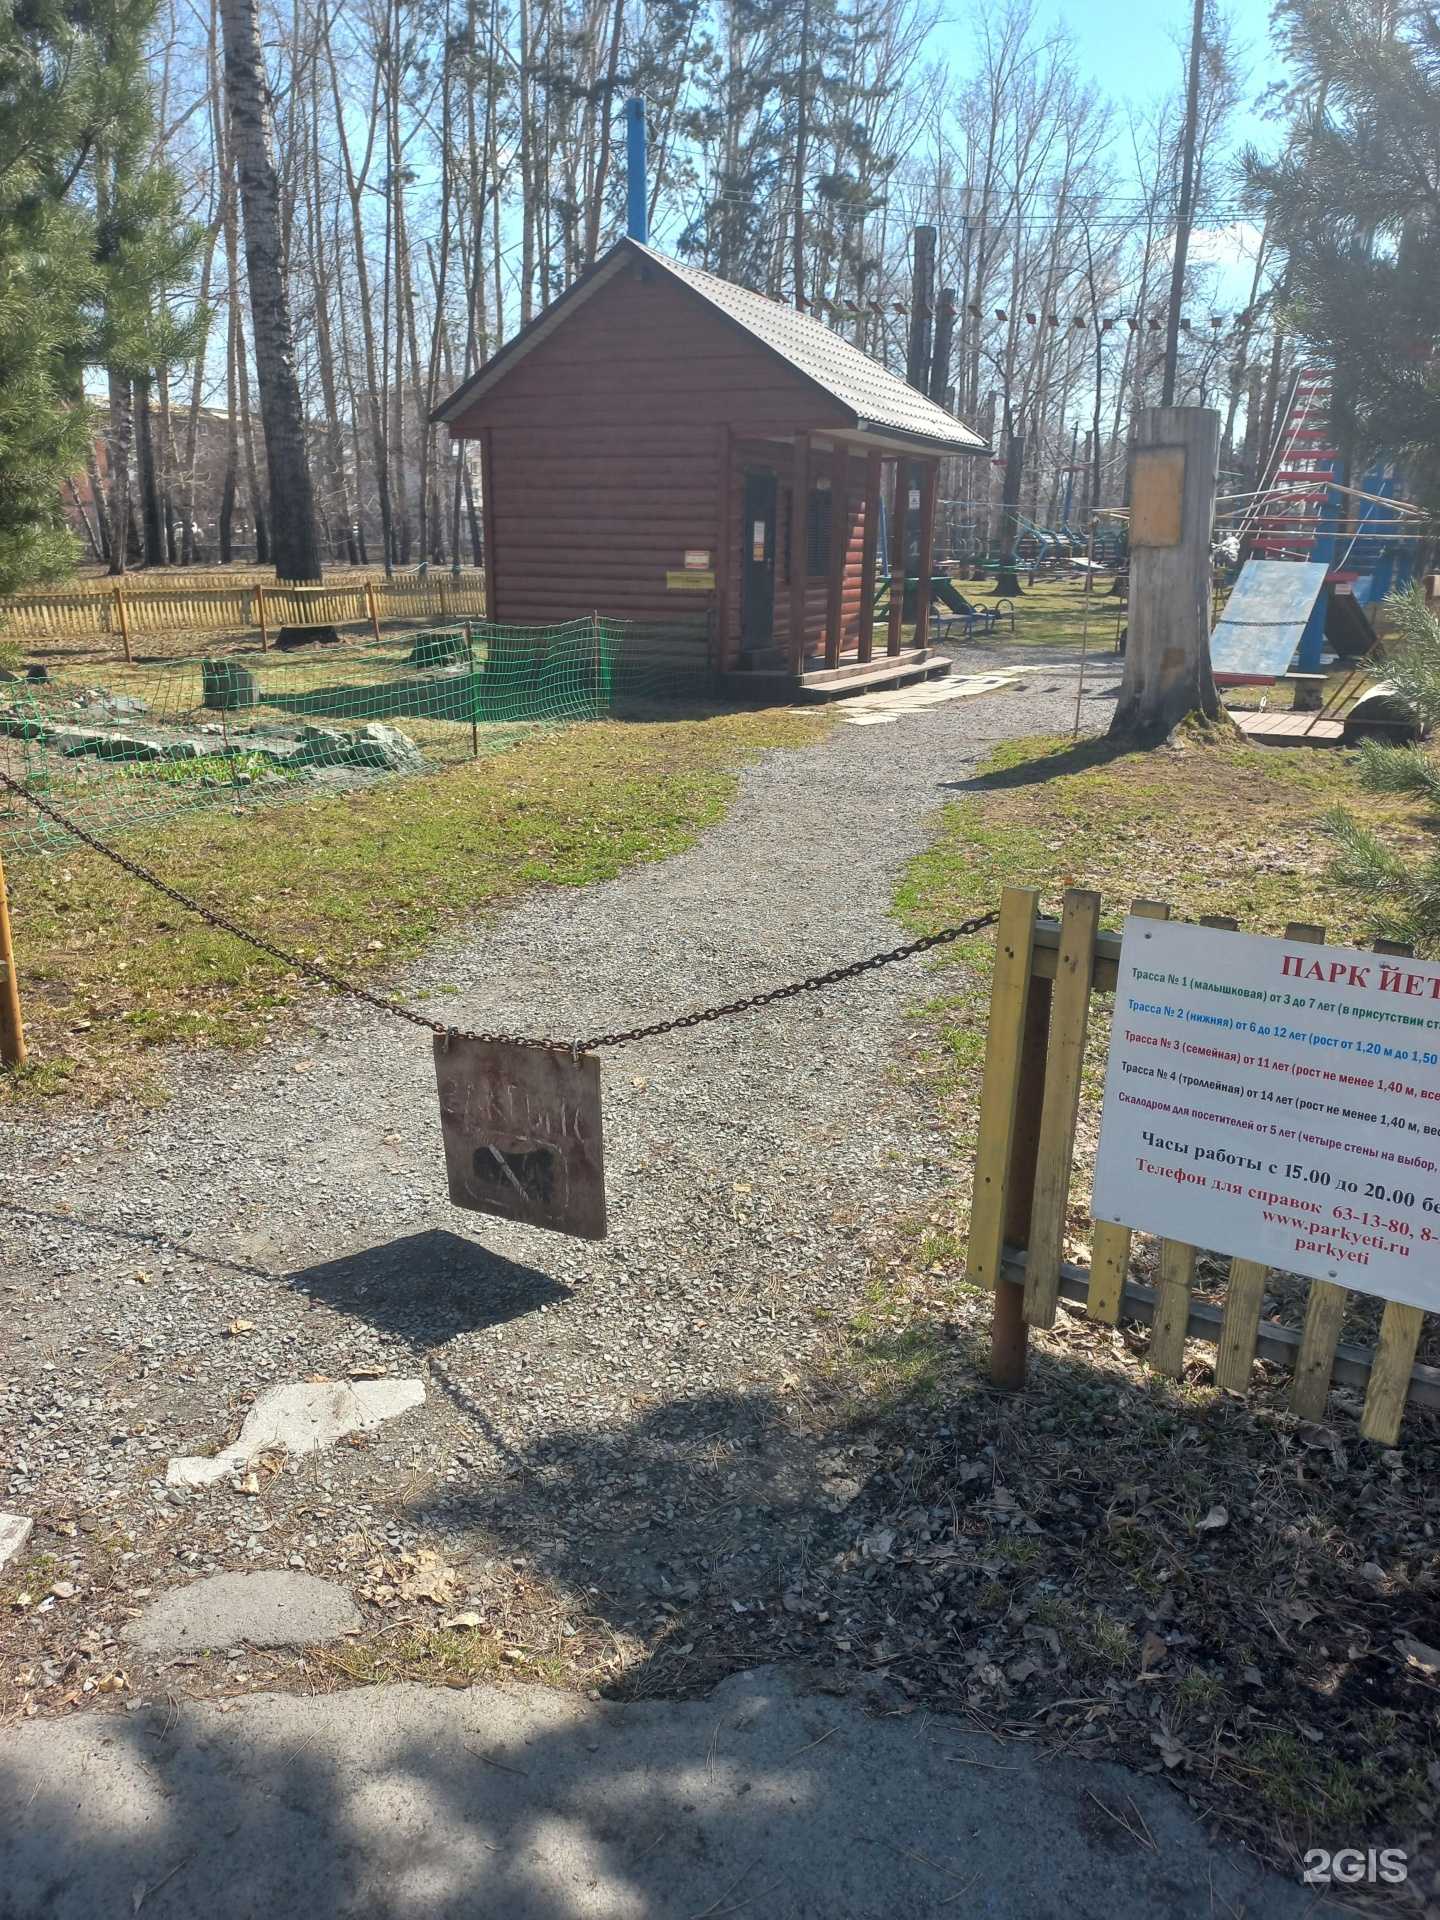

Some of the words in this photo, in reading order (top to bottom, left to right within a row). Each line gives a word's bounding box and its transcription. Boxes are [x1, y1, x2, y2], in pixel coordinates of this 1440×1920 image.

[1131, 968, 1165, 983] Трасса
[1168, 974, 1179, 985] №
[1181, 976, 1188, 987] 1
[1190, 978, 1267, 1002] (малышковая)
[1269, 993, 1282, 1003] от
[1283, 994, 1291, 1005] 3
[1292, 999, 1306, 1008] до
[1308, 998, 1316, 1009] 7
[1317, 1002, 1336, 1012] лет
[1338, 1003, 1350, 1016] (в
[1352, 1008, 1424, 1027] присутствии
[1426, 1020, 1440, 1030] ст
[1280, 955, 1371, 988] ПАРК
[1124, 1030, 1158, 1046] Трасса
[1160, 1037, 1171, 1049] №
[1173, 1040, 1180, 1050] 3
[1182, 1041, 1241, 1064] (семейная)
[1243, 1055, 1256, 1065] от
[1257, 1057, 1270, 1068] 11
[1272, 1061, 1290, 1072] лет
[1291, 1063, 1321, 1078] (рост
[1322, 1071, 1337, 1081] не
[1339, 1074, 1375, 1088] менее
[1377, 1079, 1403, 1094] 1,40
[1405, 1086, 1418, 1098] м,
[1128, 999, 1161, 1015] Трасса
[1164, 1006, 1175, 1017] №
[1177, 1008, 1184, 1019] 2
[1186, 1010, 1233, 1030] (нижняя)
[1235, 1021, 1248, 1031] от
[1249, 1022, 1257, 1033] 6
[1257, 1026, 1271, 1036] до
[1273, 1026, 1287, 1038] 12
[1289, 1031, 1307, 1042] лет
[1309, 1032, 1339, 1048] (рост
[1340, 1040, 1353, 1050] от
[1356, 1041, 1381, 1055] 1,20
[1383, 1047, 1393, 1057] м
[1394, 1050, 1409, 1060] до
[1412, 1050, 1438, 1065] 1,50
[1121, 1061, 1154, 1077] Трасса
[1156, 1068, 1168, 1080] №
[1169, 1071, 1177, 1081] 4
[1178, 1073, 1244, 1098] (троллейная)
[1246, 1088, 1259, 1099] от
[1261, 1090, 1274, 1102] 14
[1276, 1095, 1294, 1105] лет
[1295, 1096, 1325, 1112] (рост
[1326, 1105, 1340, 1115] не
[1342, 1107, 1378, 1123] менее
[1380, 1114, 1406, 1129] 1,40
[1408, 1121, 1420, 1134] м,
[1118, 1091, 1171, 1112] Скалодром
[1172, 1103, 1190, 1116] для
[1191, 1109, 1254, 1131] посетителей
[1256, 1124, 1268, 1134] от
[1269, 1124, 1277, 1135] 5
[1278, 1129, 1297, 1140] лет
[1298, 1130, 1342, 1151] (четыре
[1344, 1142, 1379, 1158] стены
[1381, 1151, 1395, 1162] на
[1397, 1155, 1438, 1173] выбор,
[1136, 1157, 1206, 1184] Телефон
[1211, 1179, 1243, 1195] для
[1247, 1187, 1322, 1214] справок
[1332, 1205, 1414, 1240] 63-13-80,
[1142, 1130, 1189, 1154] Часы
[1194, 1146, 1262, 1171] работы
[1268, 1163, 1278, 1174] с
[1284, 1163, 1331, 1186] 15.00
[1335, 1179, 1358, 1194] до
[1364, 1182, 1415, 1207] 20.00
[1262, 1210, 1410, 1257] www.parkyeti.ru
[1295, 1238, 1369, 1265] parkyeti
